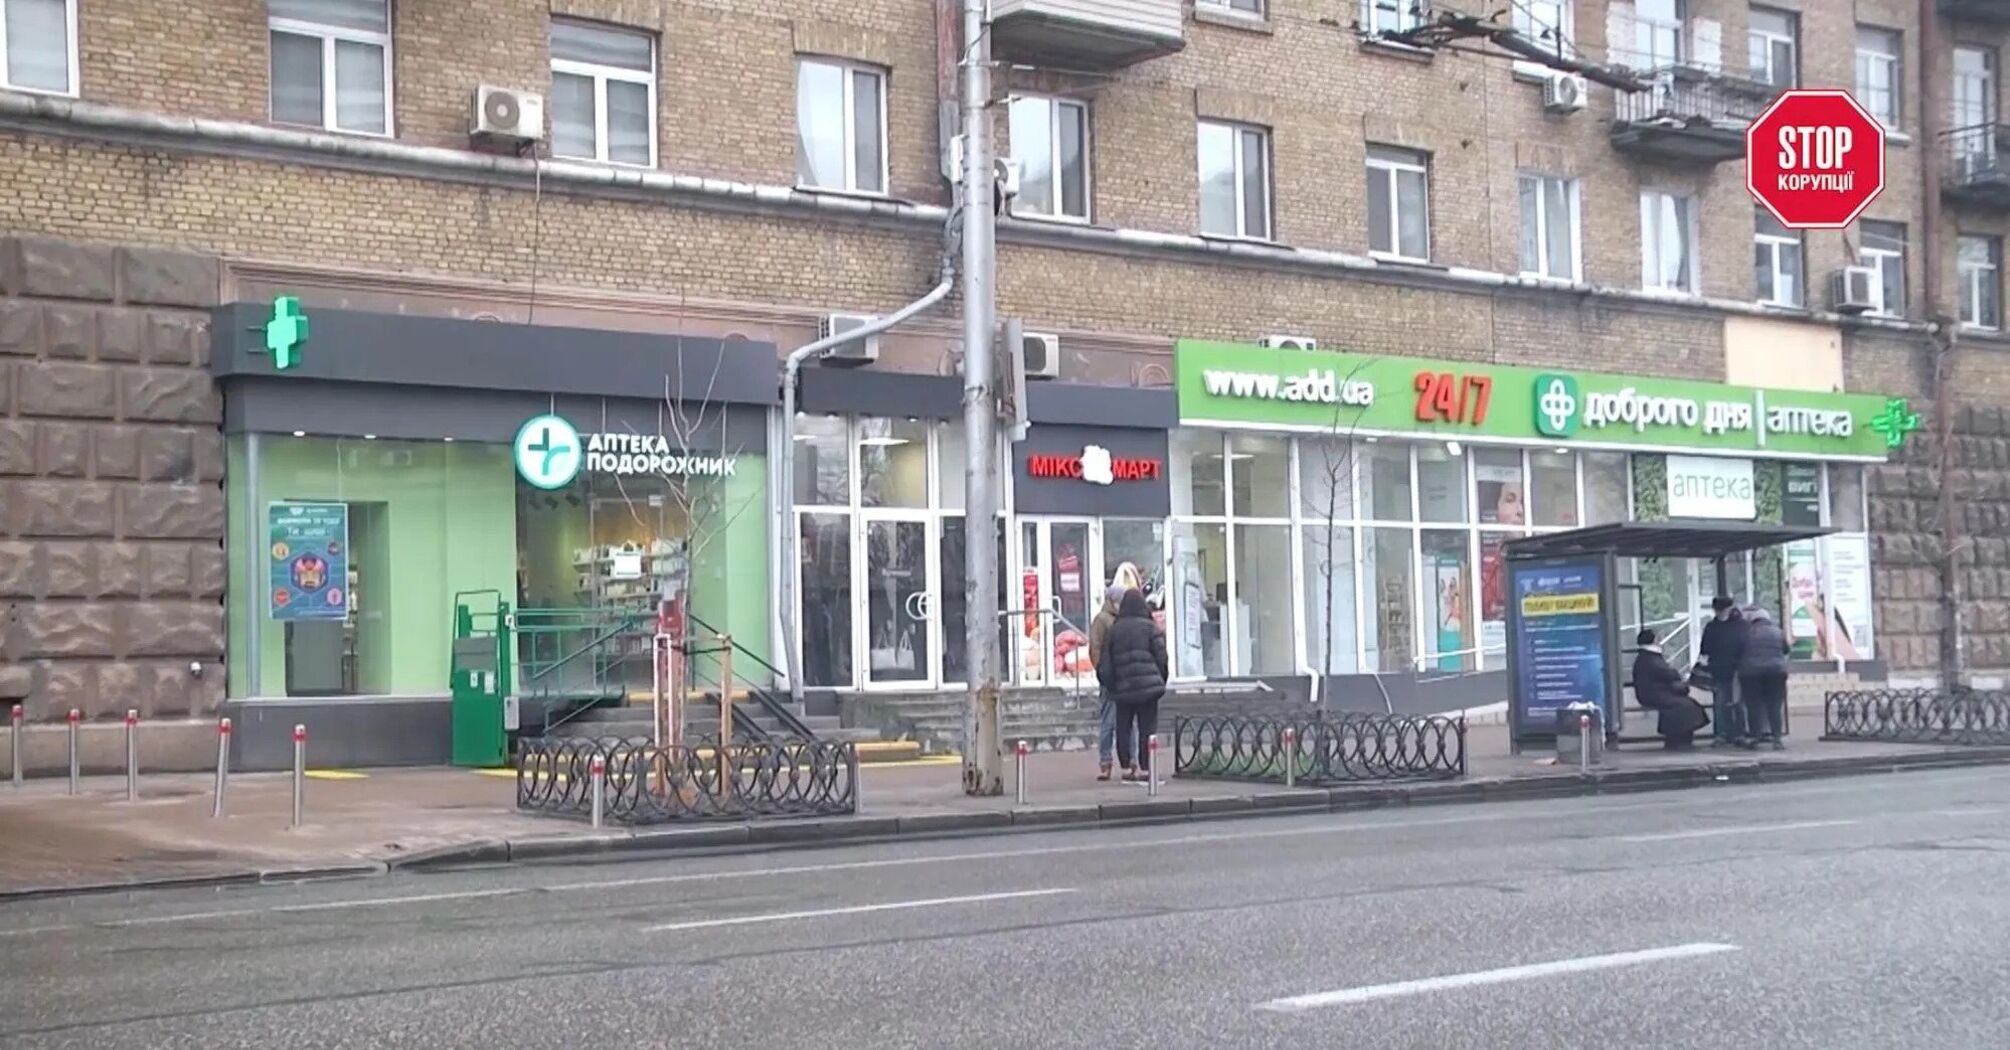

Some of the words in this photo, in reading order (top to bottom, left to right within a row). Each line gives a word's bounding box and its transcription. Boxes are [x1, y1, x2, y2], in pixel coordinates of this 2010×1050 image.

[1203, 368, 1374, 406] www.add.ua
[1413, 368, 1492, 426] 24/7
[1583, 387, 1699, 432] доброго
[1703, 400, 1752, 434] дня
[1767, 406, 1852, 437] аптека
[587, 433, 670, 454] АПТЕКА
[587, 452, 736, 477] ПОДОРОЖНИК
[1112, 458, 1162, 480] МАРТ
[1673, 473, 1752, 501] аптека
